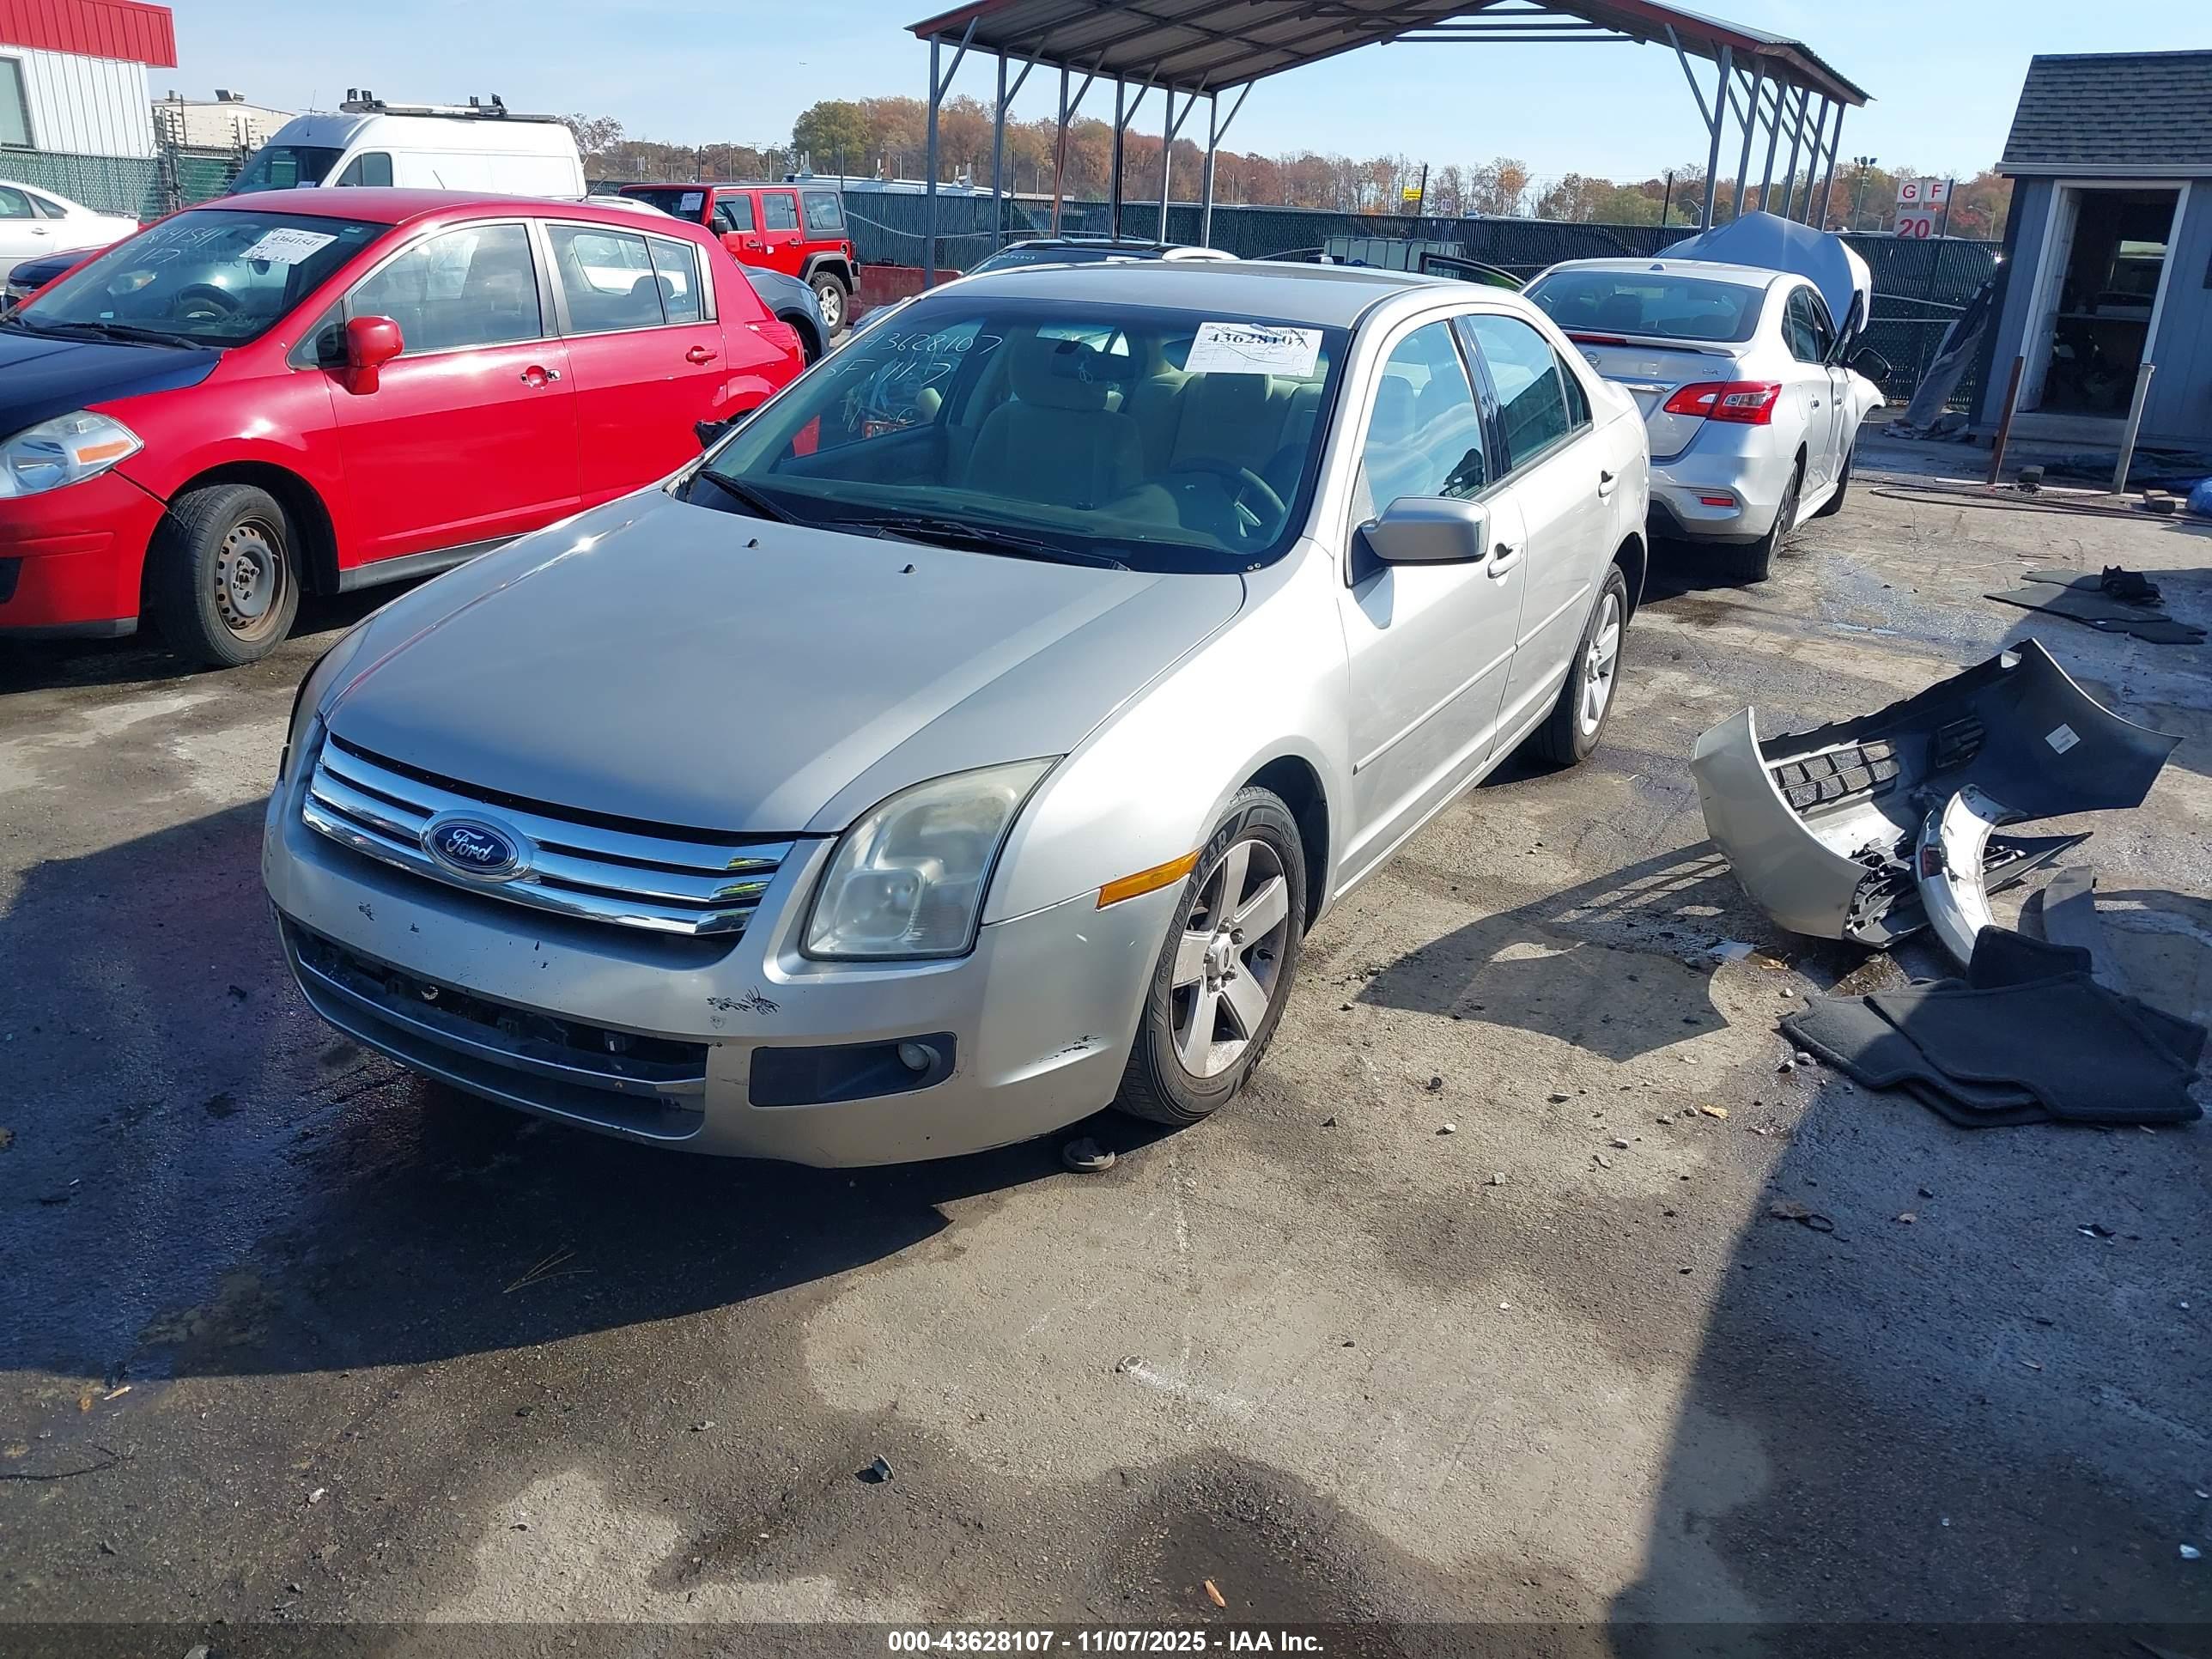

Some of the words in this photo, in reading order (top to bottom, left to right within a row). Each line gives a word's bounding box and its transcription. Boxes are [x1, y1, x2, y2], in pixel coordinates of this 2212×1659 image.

[1903, 185, 1916, 198] G
[1931, 185, 1942, 198] F
[1898, 219, 1929, 238] 20
[864, 332, 1003, 356] 43628107
[446, 829, 495, 862] Ford
